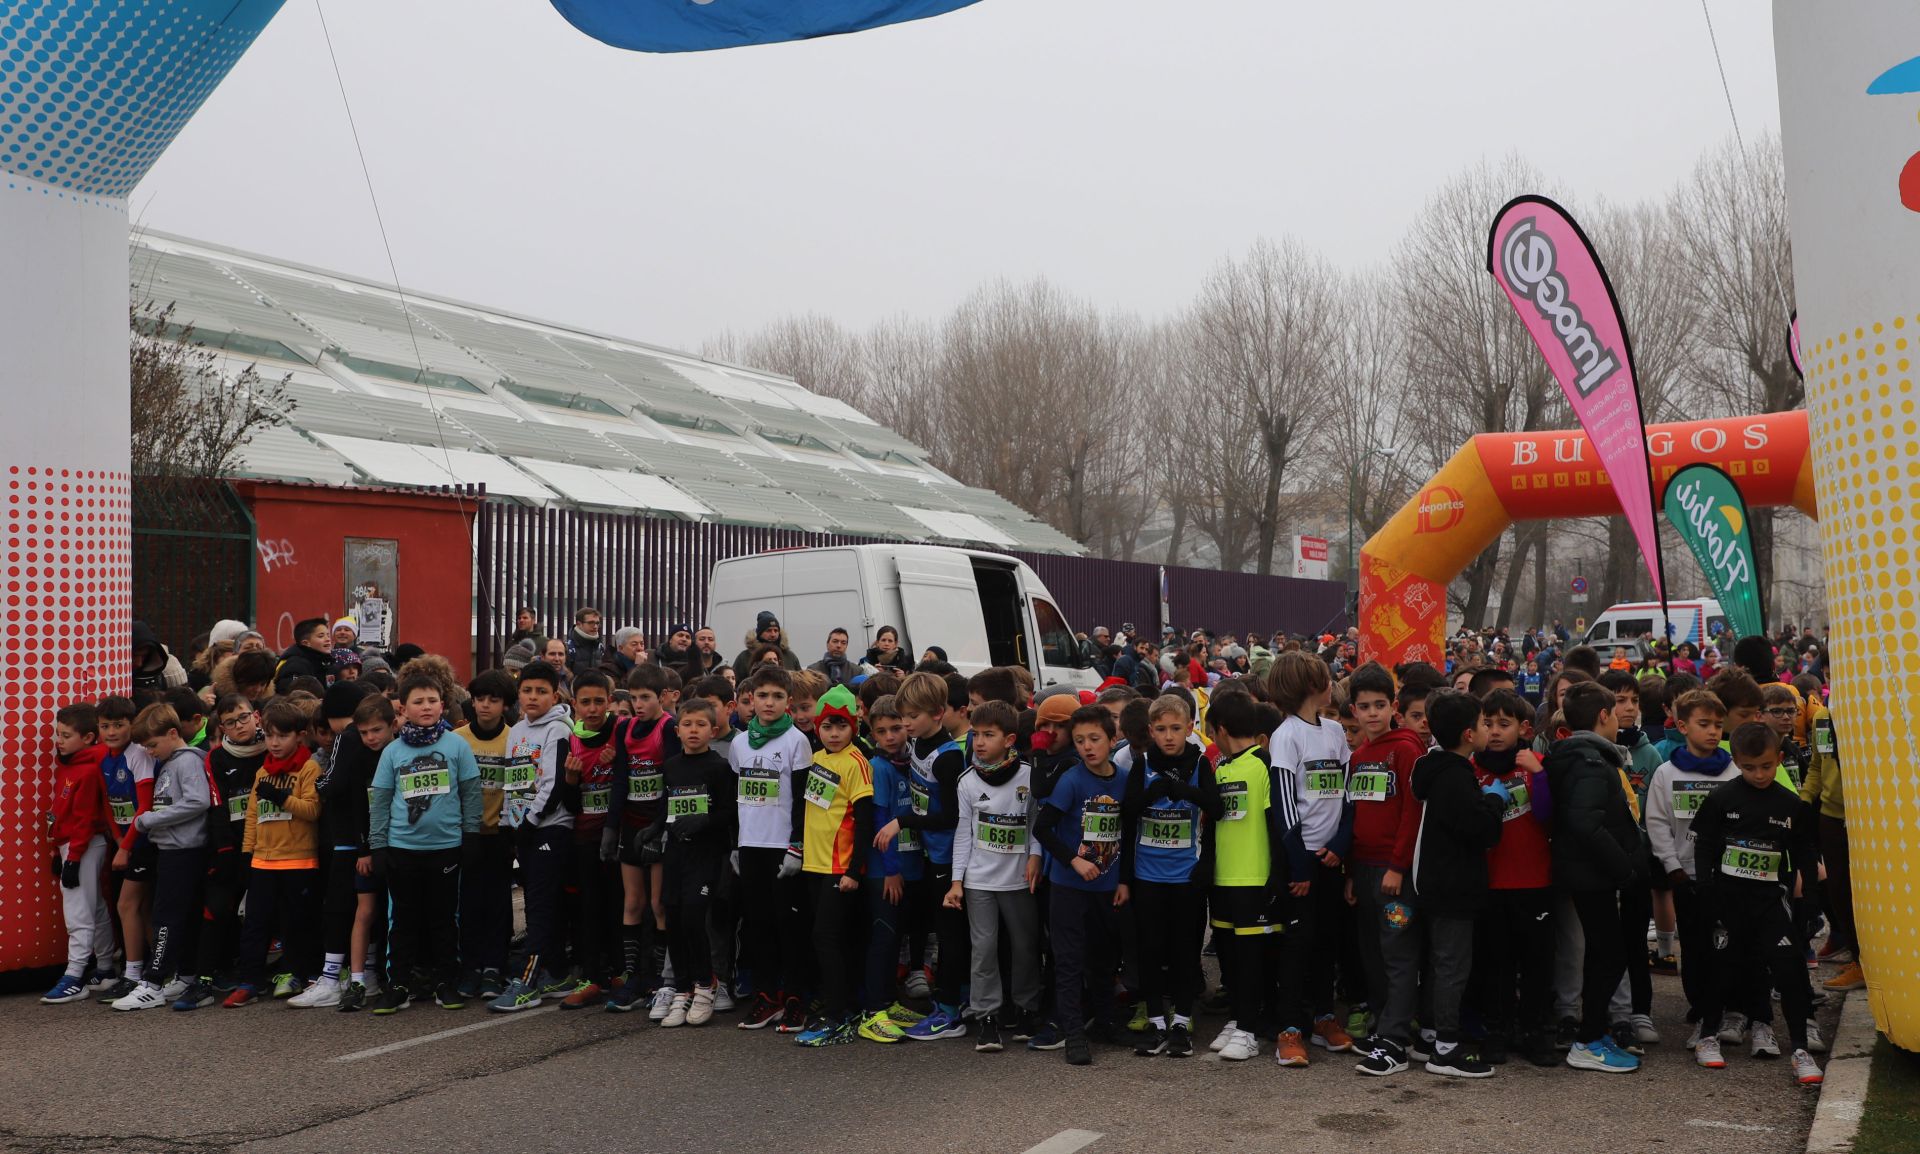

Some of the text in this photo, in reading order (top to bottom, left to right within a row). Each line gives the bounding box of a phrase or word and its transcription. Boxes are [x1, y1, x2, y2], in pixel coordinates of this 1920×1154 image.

[1511, 423, 1769, 466] BUGOS
[1418, 498, 1465, 514] deportes
[413, 773, 439, 789] 635
[512, 767, 528, 782] 583
[1320, 773, 1337, 789] 577
[633, 779, 658, 793] 682
[745, 781, 767, 796] 666
[1355, 775, 1375, 791] 701
[675, 799, 698, 814] 596
[989, 828, 1016, 844] 636
[1152, 823, 1180, 839] 642
[1748, 840, 1773, 849] CaixaBank
[1738, 851, 1770, 871] 623
[1735, 867, 1760, 877] FIATC
